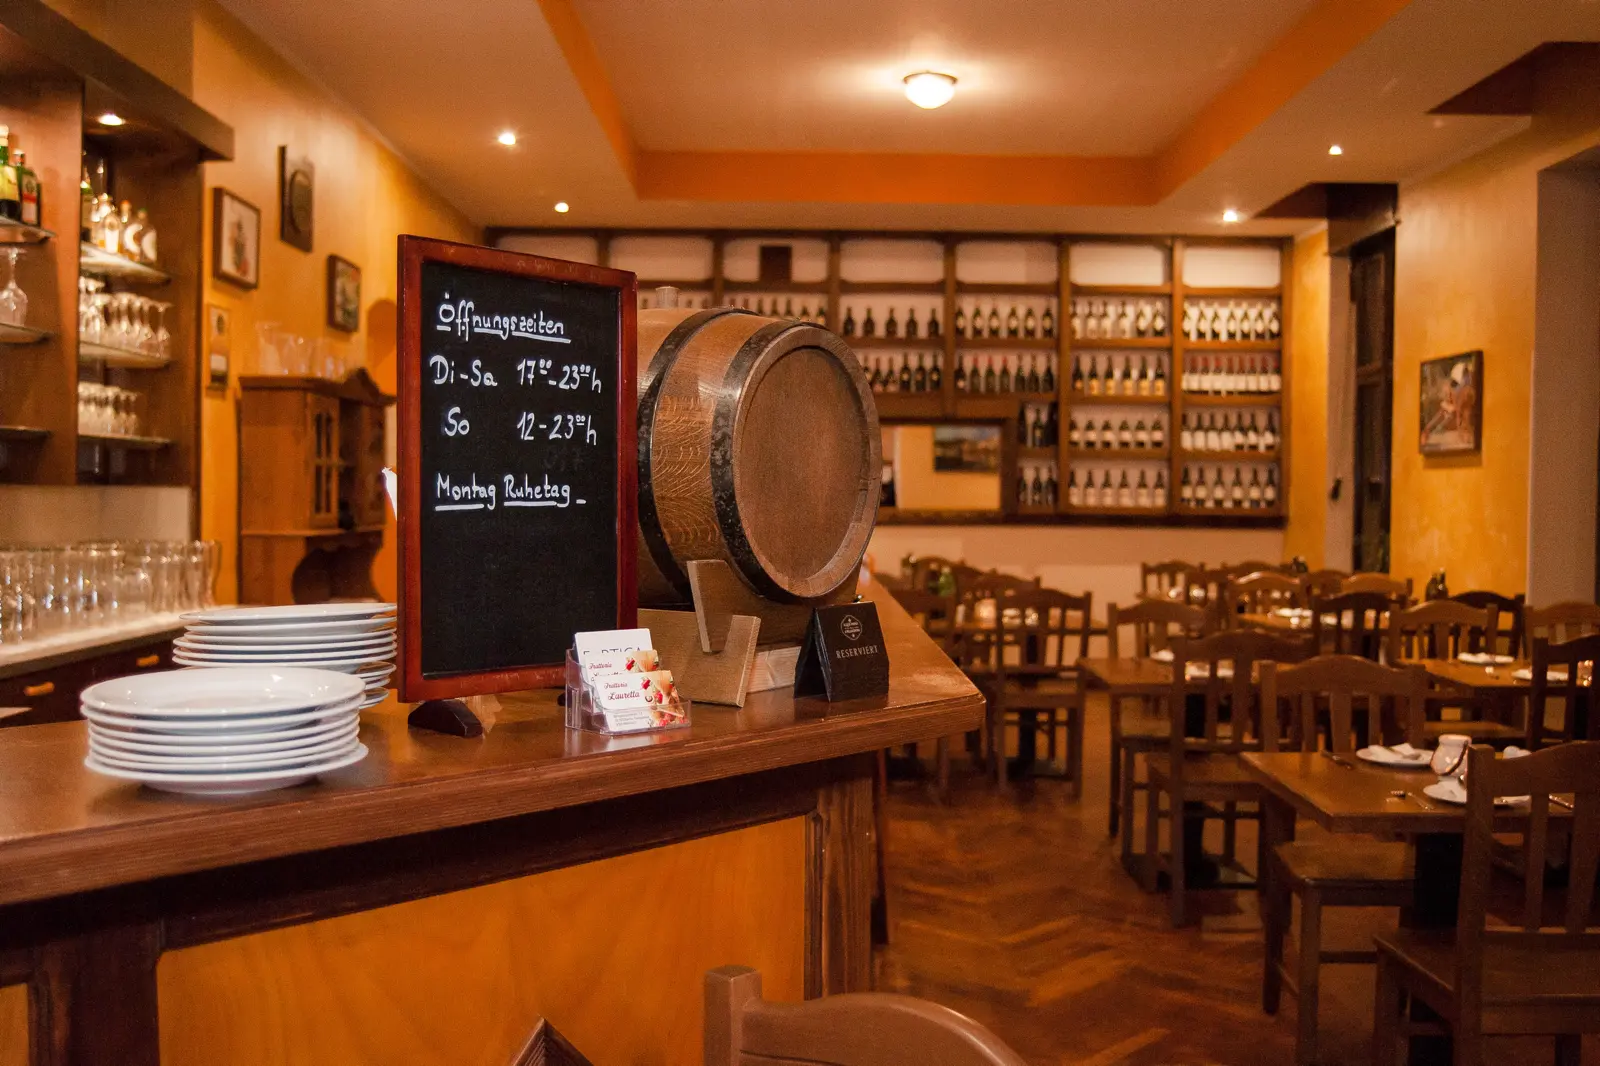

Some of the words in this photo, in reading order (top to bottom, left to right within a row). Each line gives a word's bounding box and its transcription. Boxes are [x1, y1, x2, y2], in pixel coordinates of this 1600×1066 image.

[439, 292, 565, 342] Öffnungszeiten
[444, 406, 470, 437] So
[436, 472, 496, 511] Montag
[503, 473, 571, 508] Ruhetag
[835, 645, 878, 659] RESERVIERT
[608, 691, 641, 701] Lauretta
